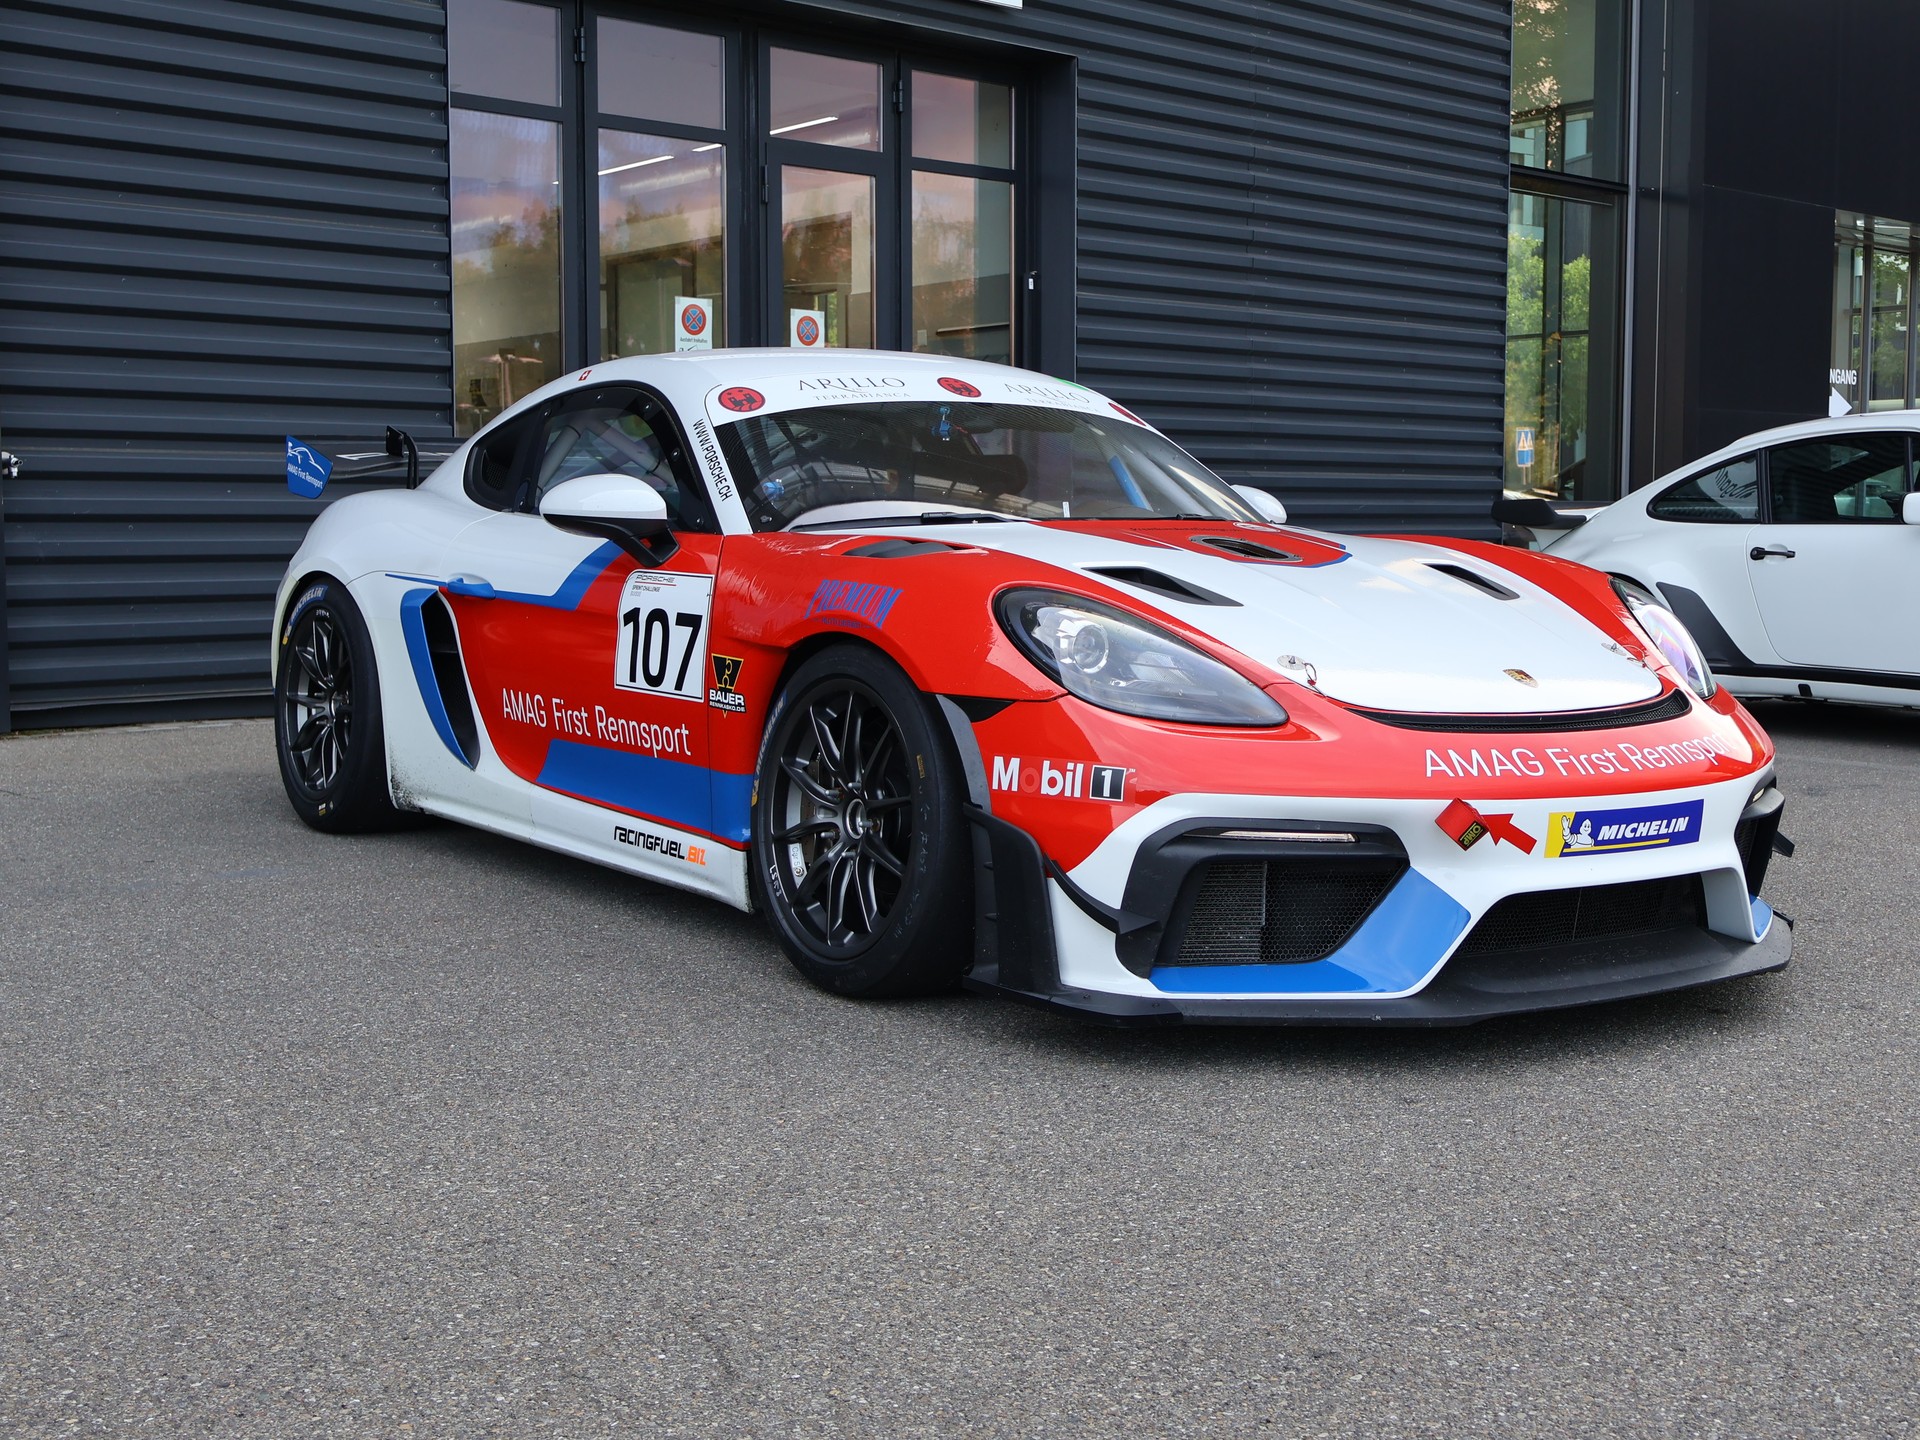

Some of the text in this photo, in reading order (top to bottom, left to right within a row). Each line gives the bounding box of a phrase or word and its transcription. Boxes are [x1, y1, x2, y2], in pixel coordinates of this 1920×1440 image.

[799, 377, 905, 392] ARILLO
[815, 392, 911, 401] TERRABIANCA
[1004, 383, 1090, 403] ARILLO
[692, 418, 733, 502] WWW.PORSCHE.CH
[636, 574, 676, 583] PORSCHE
[803, 579, 904, 629] PREMIUM
[623, 607, 703, 691] 107
[709, 689, 745, 706] BAUER
[502, 688, 691, 758] AMAG First Rennsport
[756, 696, 784, 775] MICHELIN
[1425, 748, 1545, 777] AMAG
[1544, 747, 1630, 776] First
[992, 756, 1084, 798] Mobil
[1463, 824, 1482, 845] OMP
[1597, 816, 1689, 840] MICHELIN
